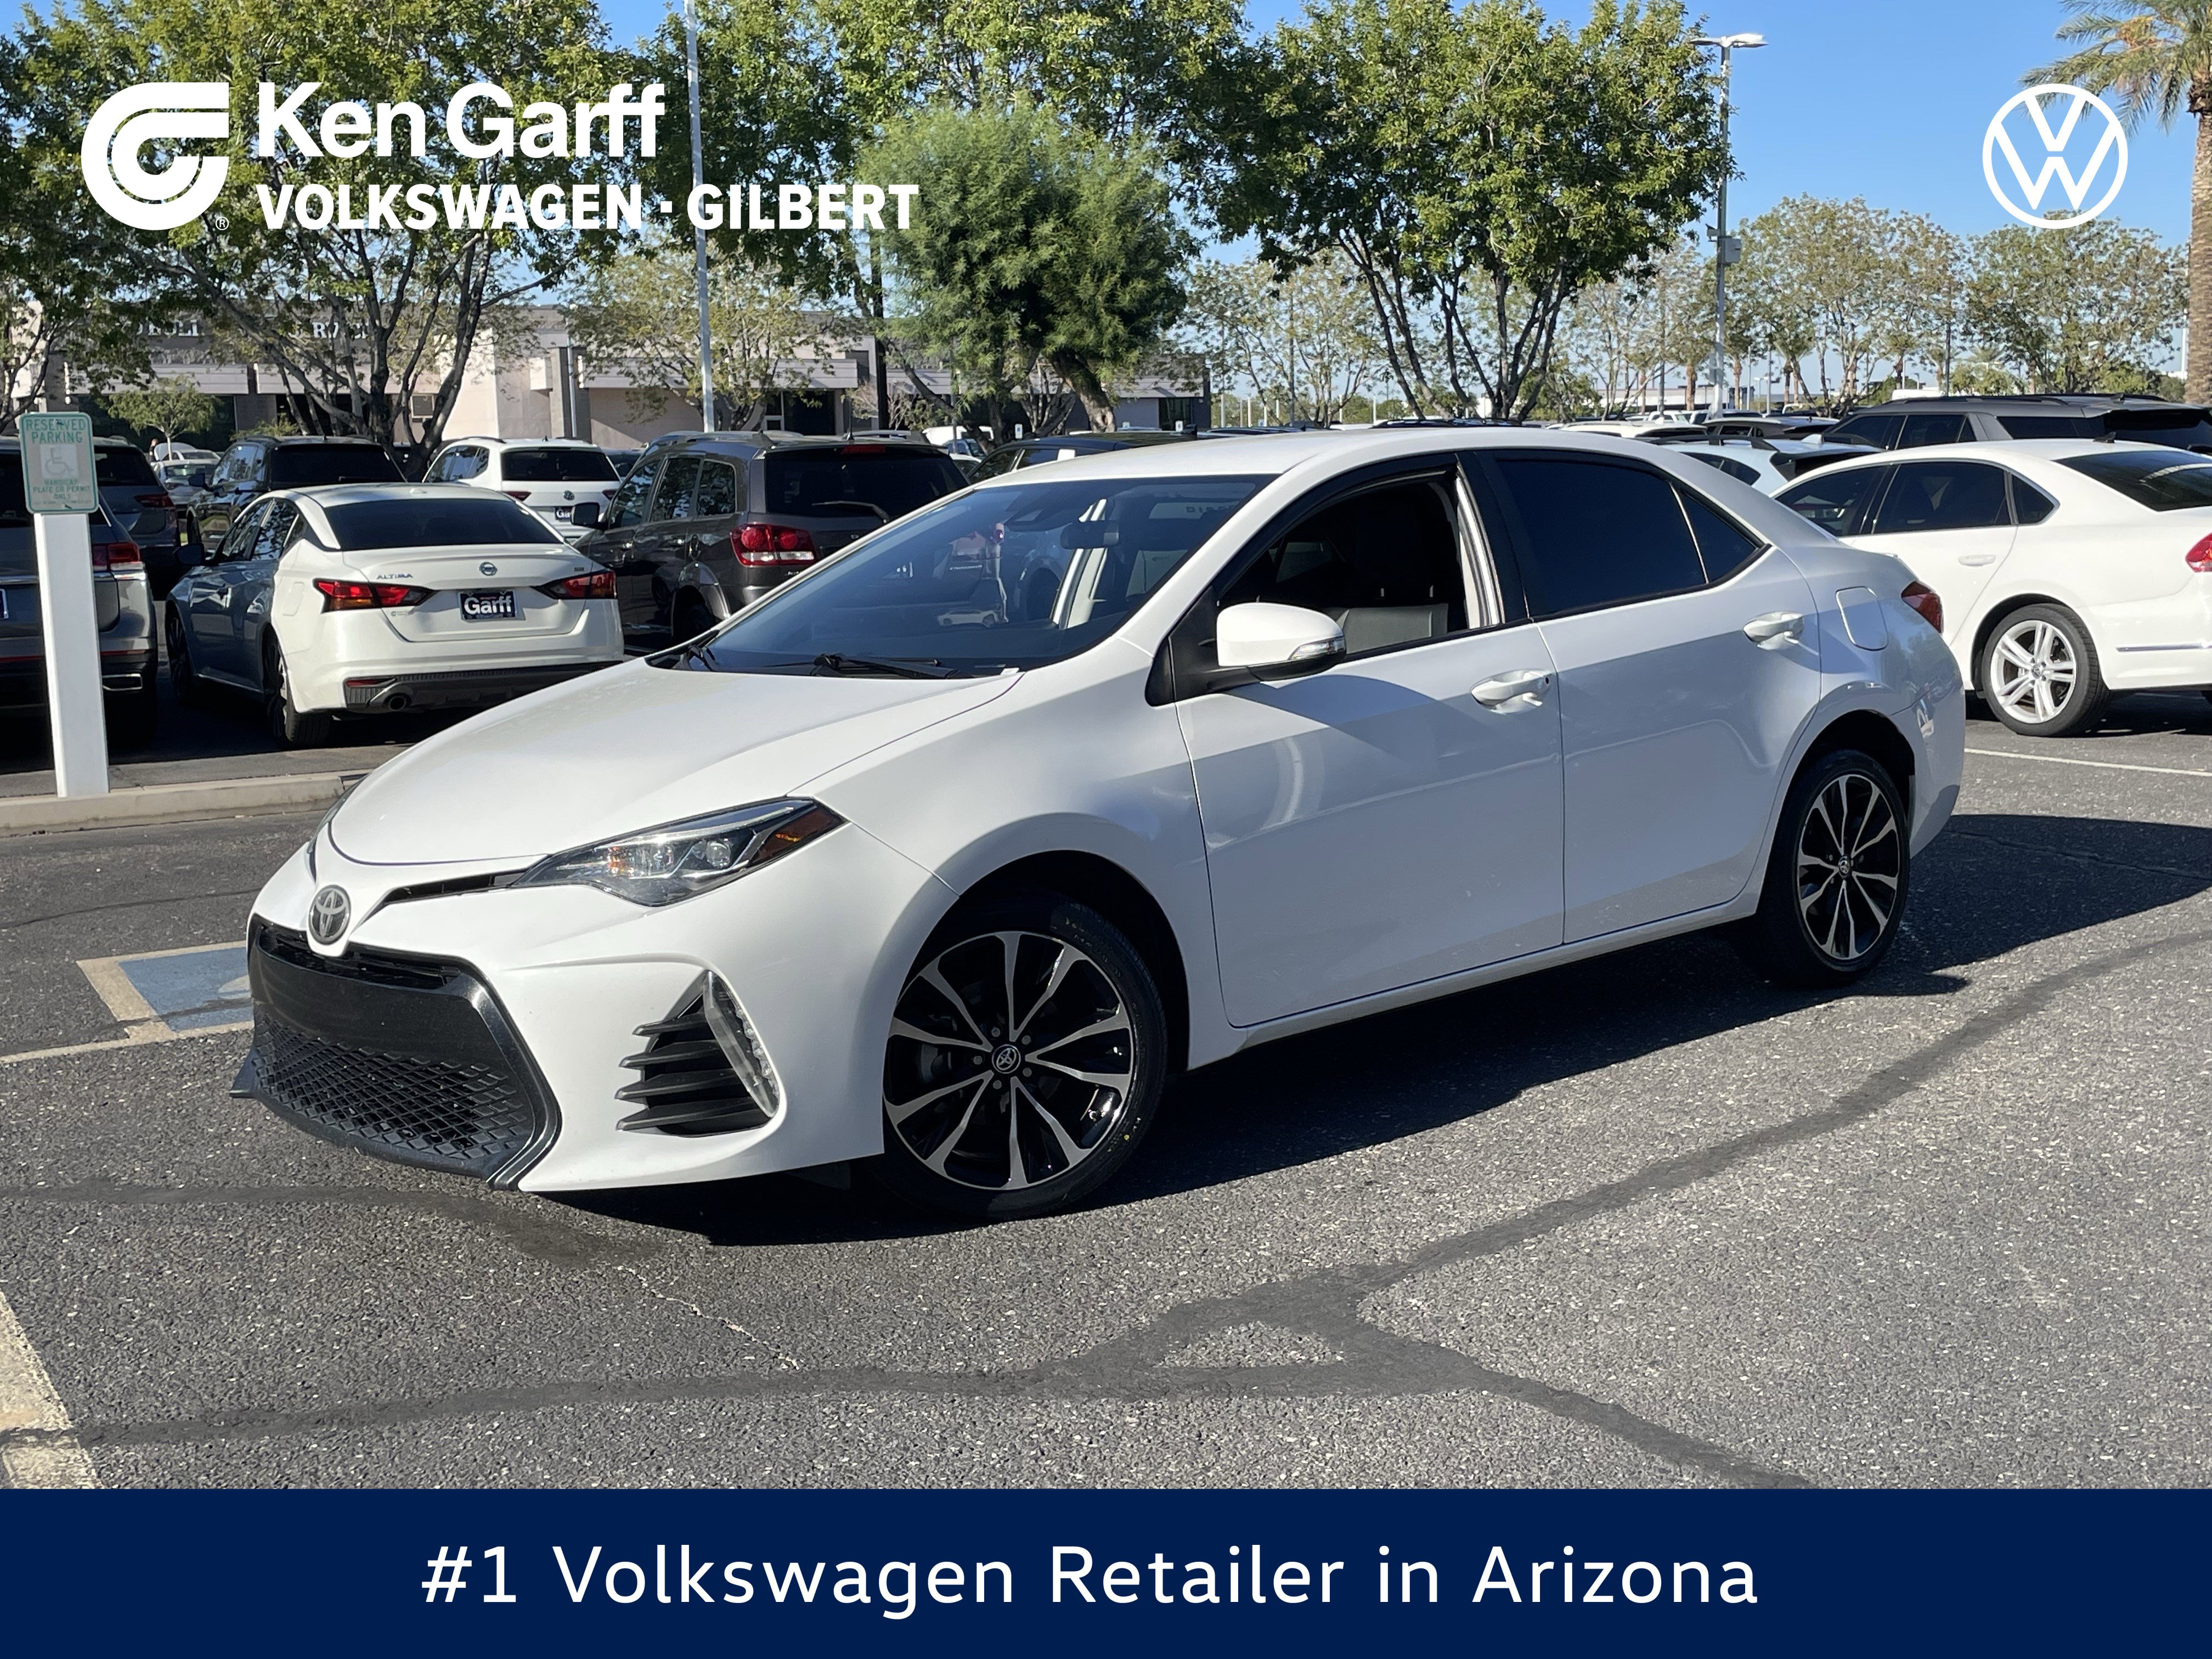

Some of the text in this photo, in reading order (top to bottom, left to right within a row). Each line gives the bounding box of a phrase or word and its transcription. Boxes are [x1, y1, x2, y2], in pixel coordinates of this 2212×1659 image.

[25, 419, 86, 431] RESERVED
[31, 431, 83, 444] PARKING
[464, 595, 511, 614] Garff
